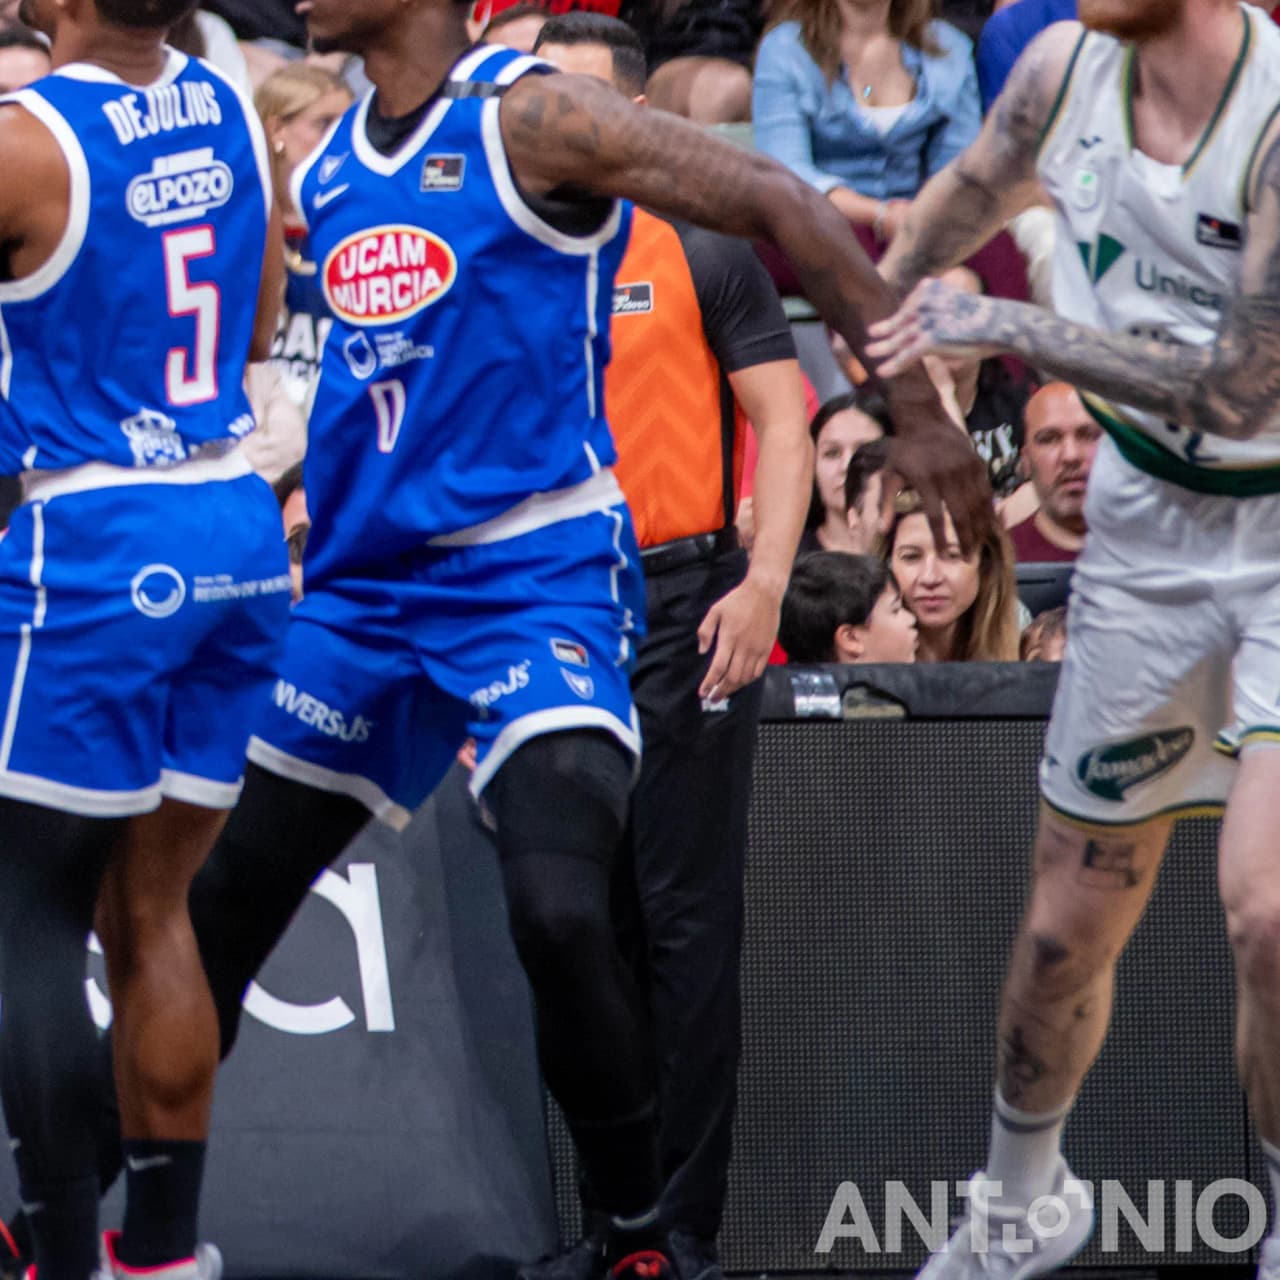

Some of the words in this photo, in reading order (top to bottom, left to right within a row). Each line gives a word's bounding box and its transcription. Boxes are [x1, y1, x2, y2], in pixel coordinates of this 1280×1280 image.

[101, 80, 223, 145] DEJULIUS
[339, 234, 426, 280] UCAM
[162, 223, 221, 406] 5
[332, 268, 442, 316] MURCIA
